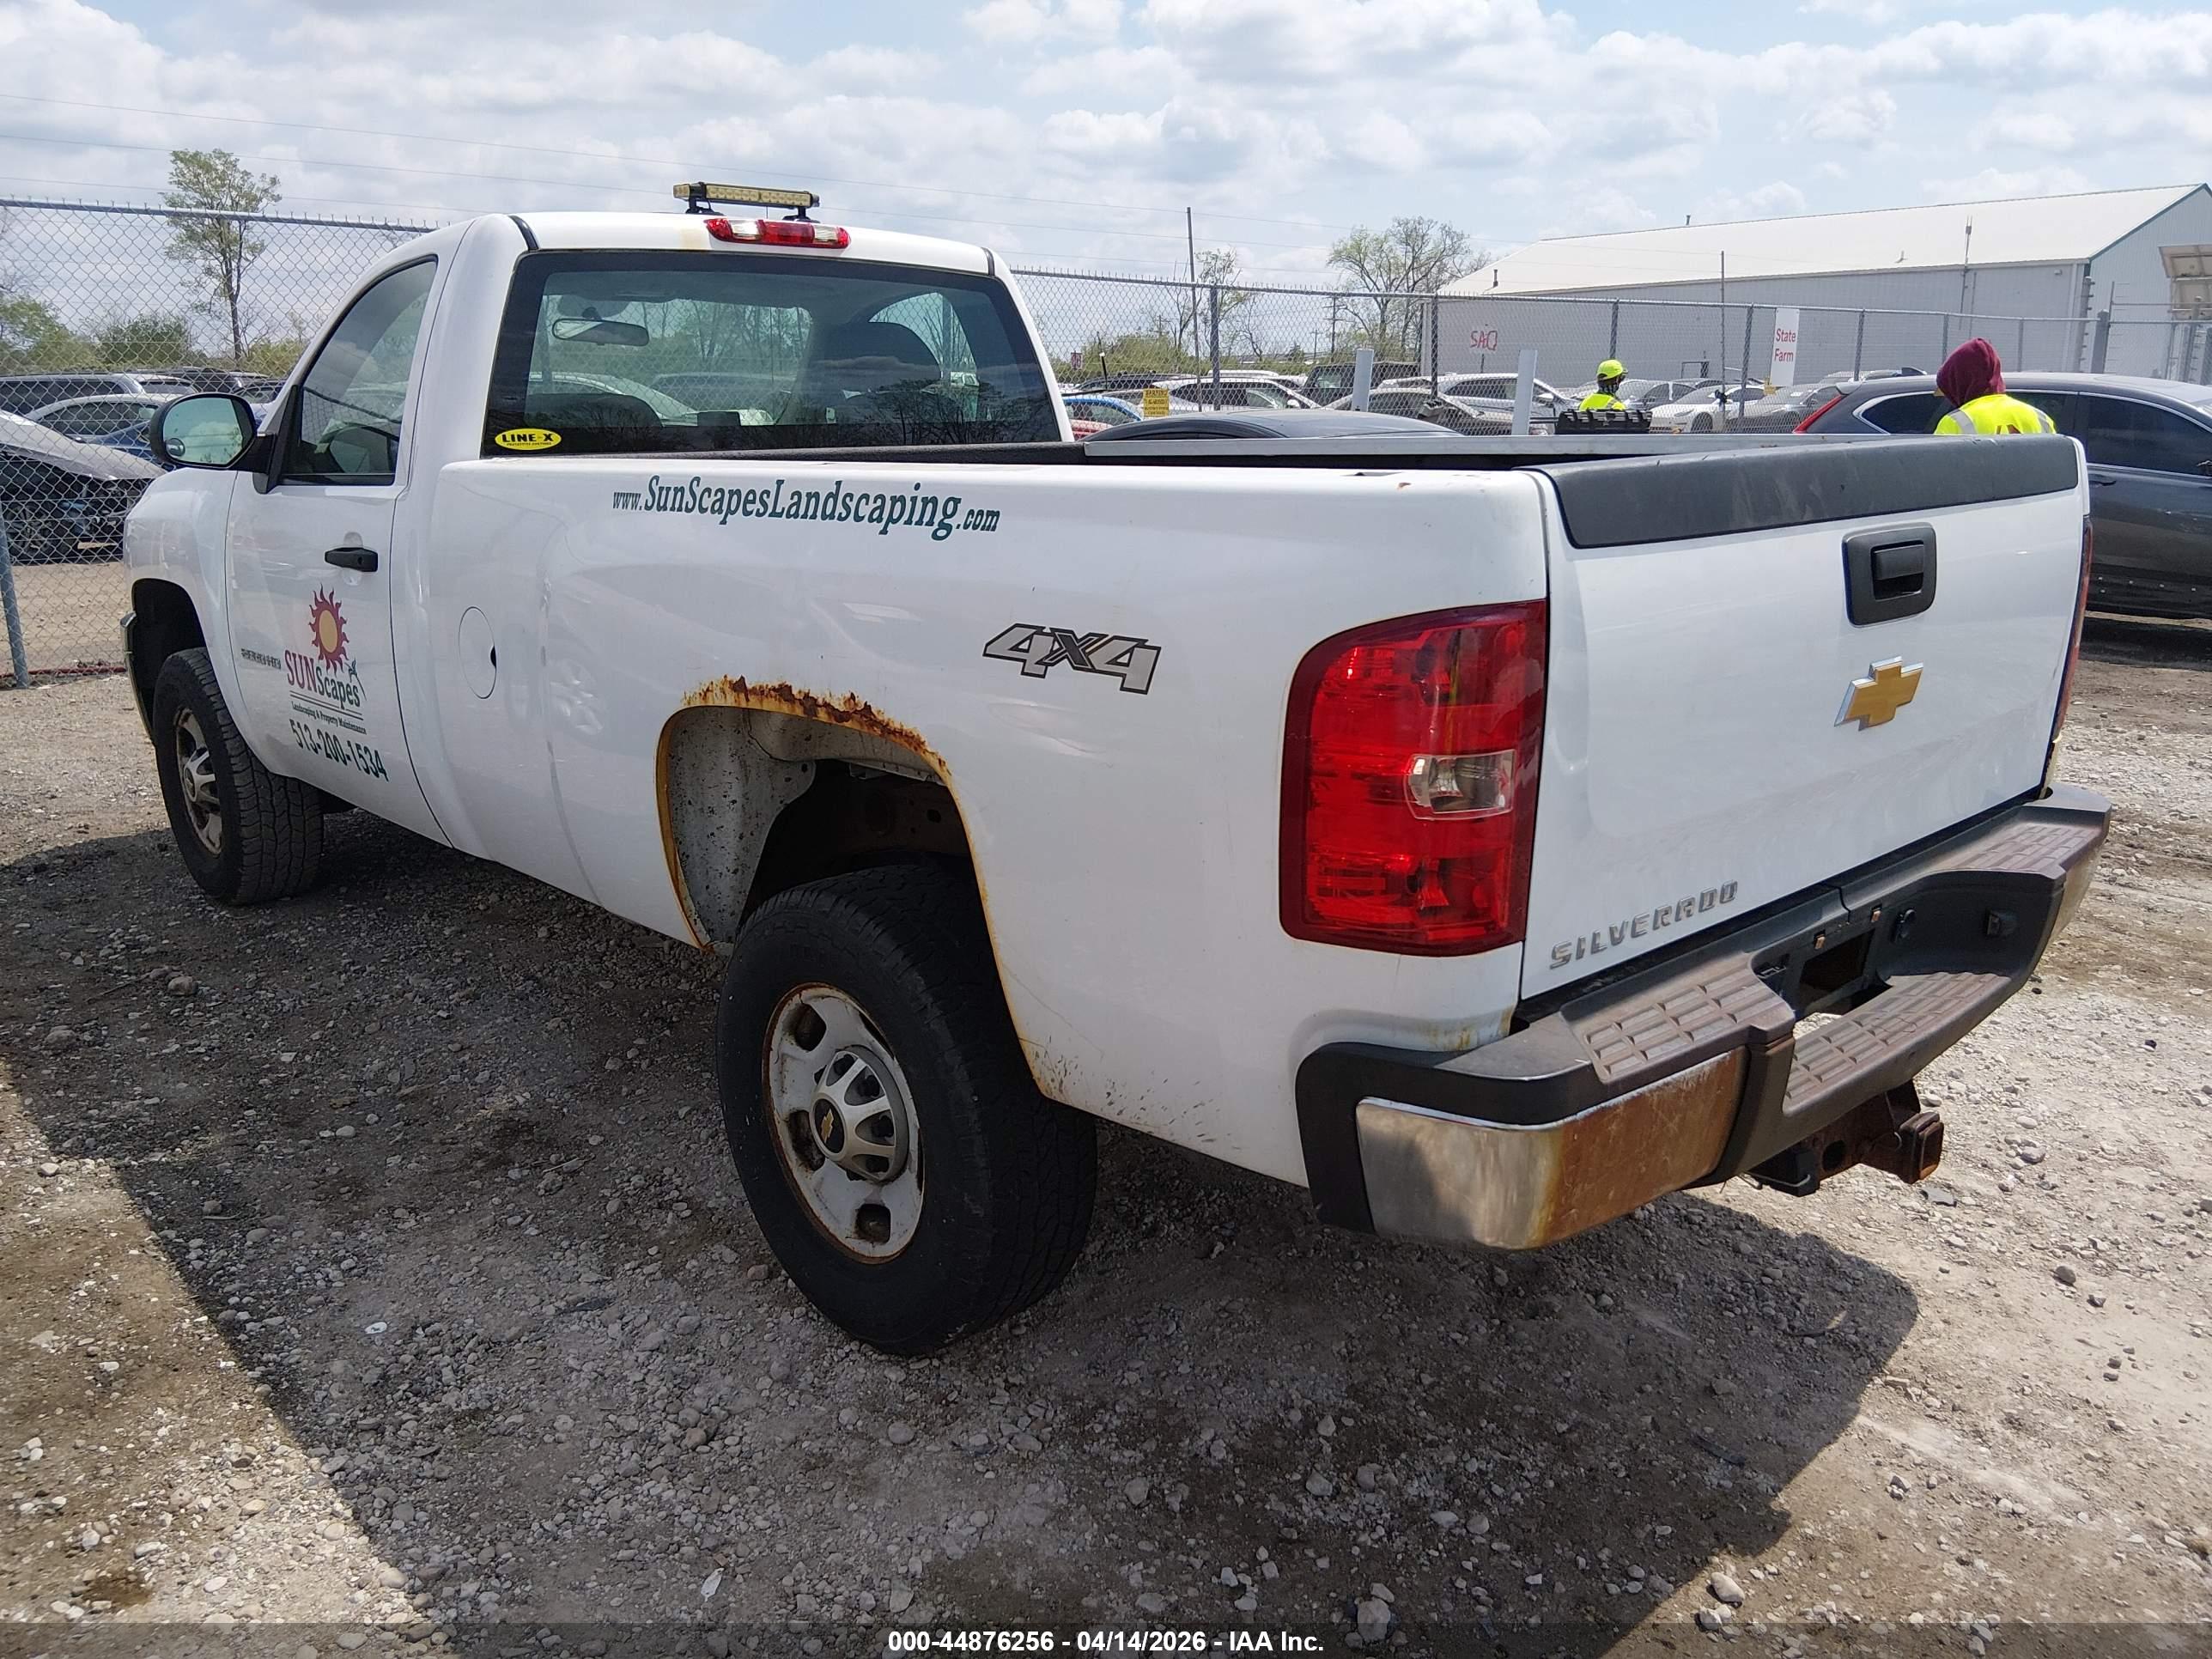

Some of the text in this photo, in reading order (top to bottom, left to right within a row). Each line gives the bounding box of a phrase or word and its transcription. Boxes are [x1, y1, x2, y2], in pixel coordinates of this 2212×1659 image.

[1774, 348, 1794, 362] Farm
[1775, 328, 1796, 343] State
[501, 433, 555, 443] LINE-X
[612, 475, 1001, 542] www.SunScapesLandscaping.com
[289, 718, 390, 783] 513-200-1534
[1549, 879, 1739, 970] SILVERADO
